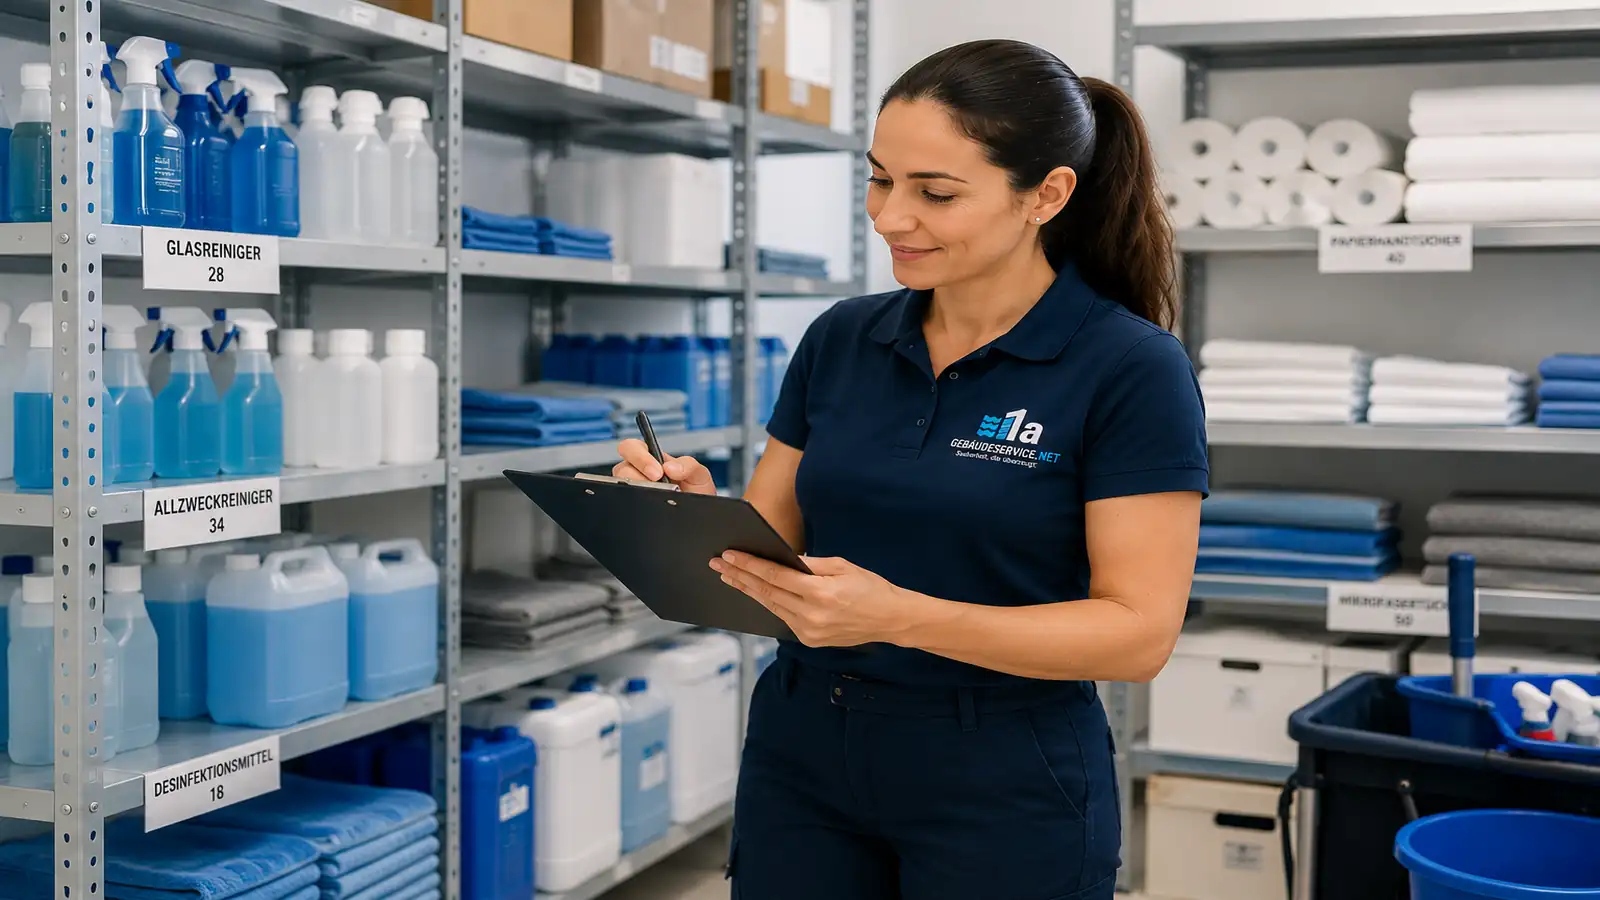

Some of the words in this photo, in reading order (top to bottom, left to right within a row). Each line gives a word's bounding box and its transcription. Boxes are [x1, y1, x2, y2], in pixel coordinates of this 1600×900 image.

[166, 239, 261, 261] GLASREINIGER
[208, 266, 224, 282] 28
[1004, 408, 1044, 445] 1a
[154, 489, 273, 516] ALLZWECKREINIGER
[209, 517, 225, 533] 34
[154, 749, 274, 797] DESINFEKTIONSMITTEL
[210, 785, 224, 802] 18
